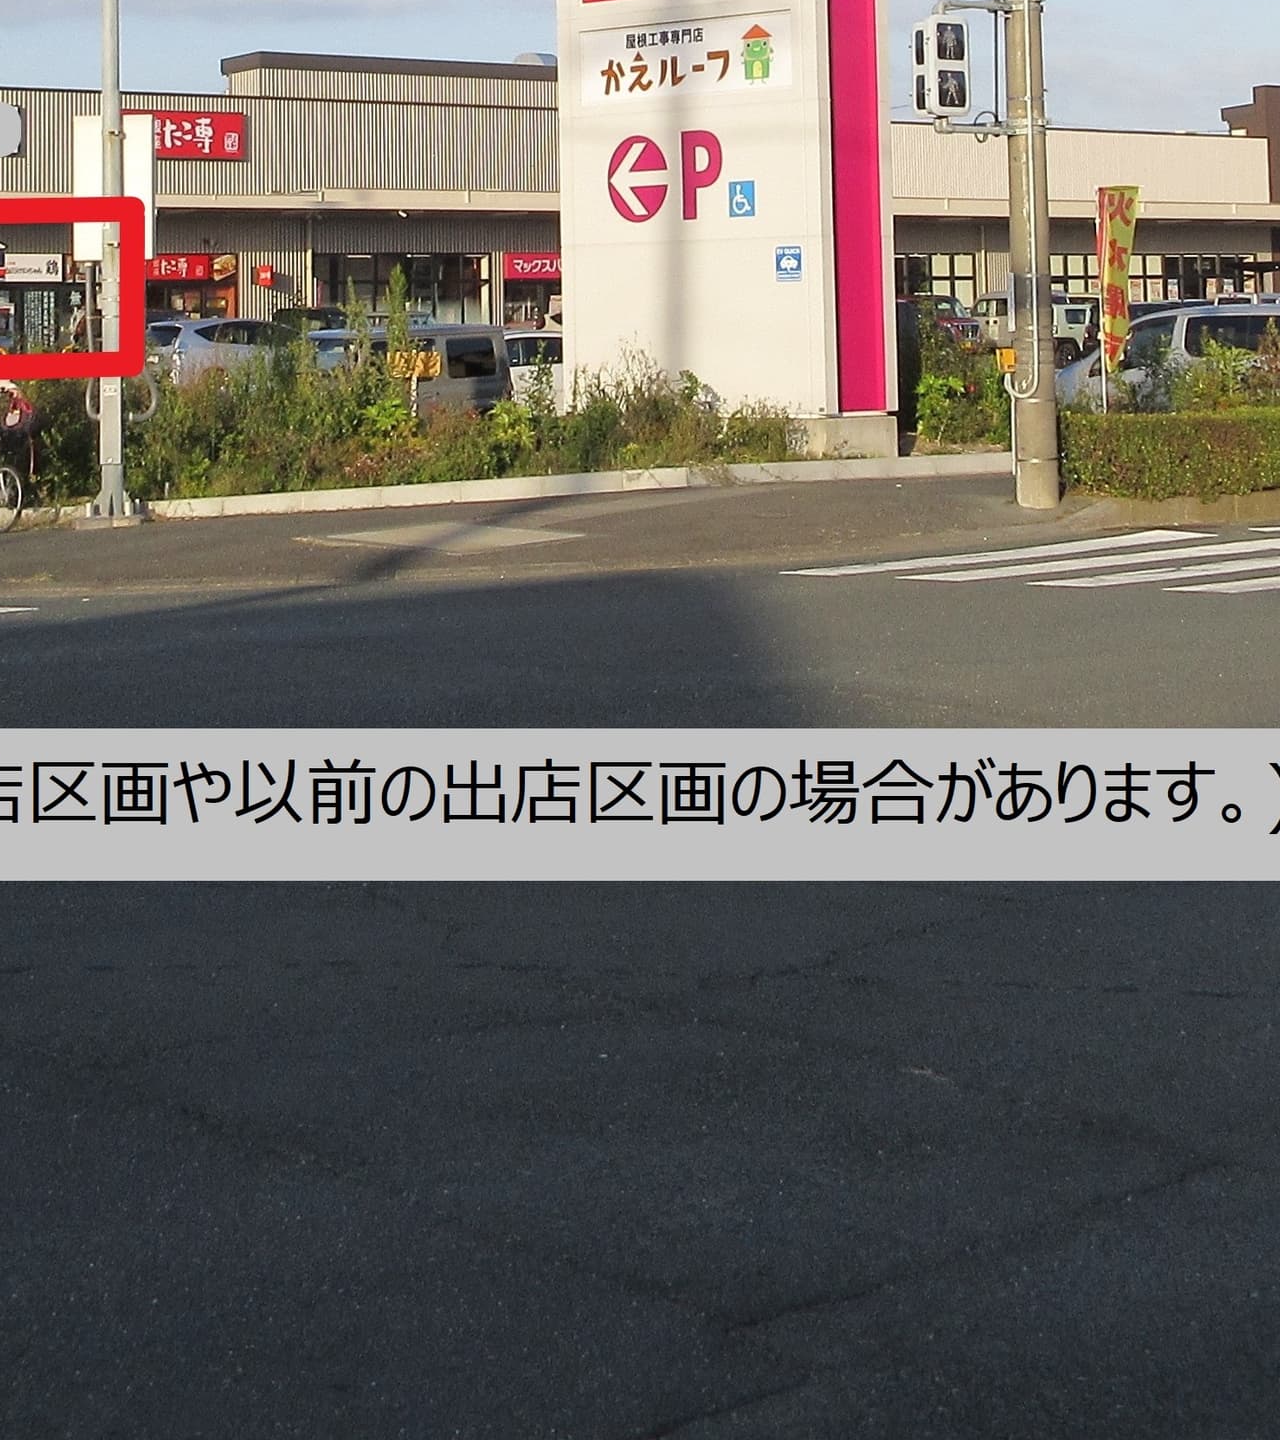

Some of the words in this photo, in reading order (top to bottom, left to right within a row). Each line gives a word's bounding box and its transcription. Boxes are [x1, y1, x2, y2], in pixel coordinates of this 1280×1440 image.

[626, 28, 703, 49] 屋根工事専門店
[601, 50, 730, 95] かえルーフ
[681, 130, 723, 220] P
